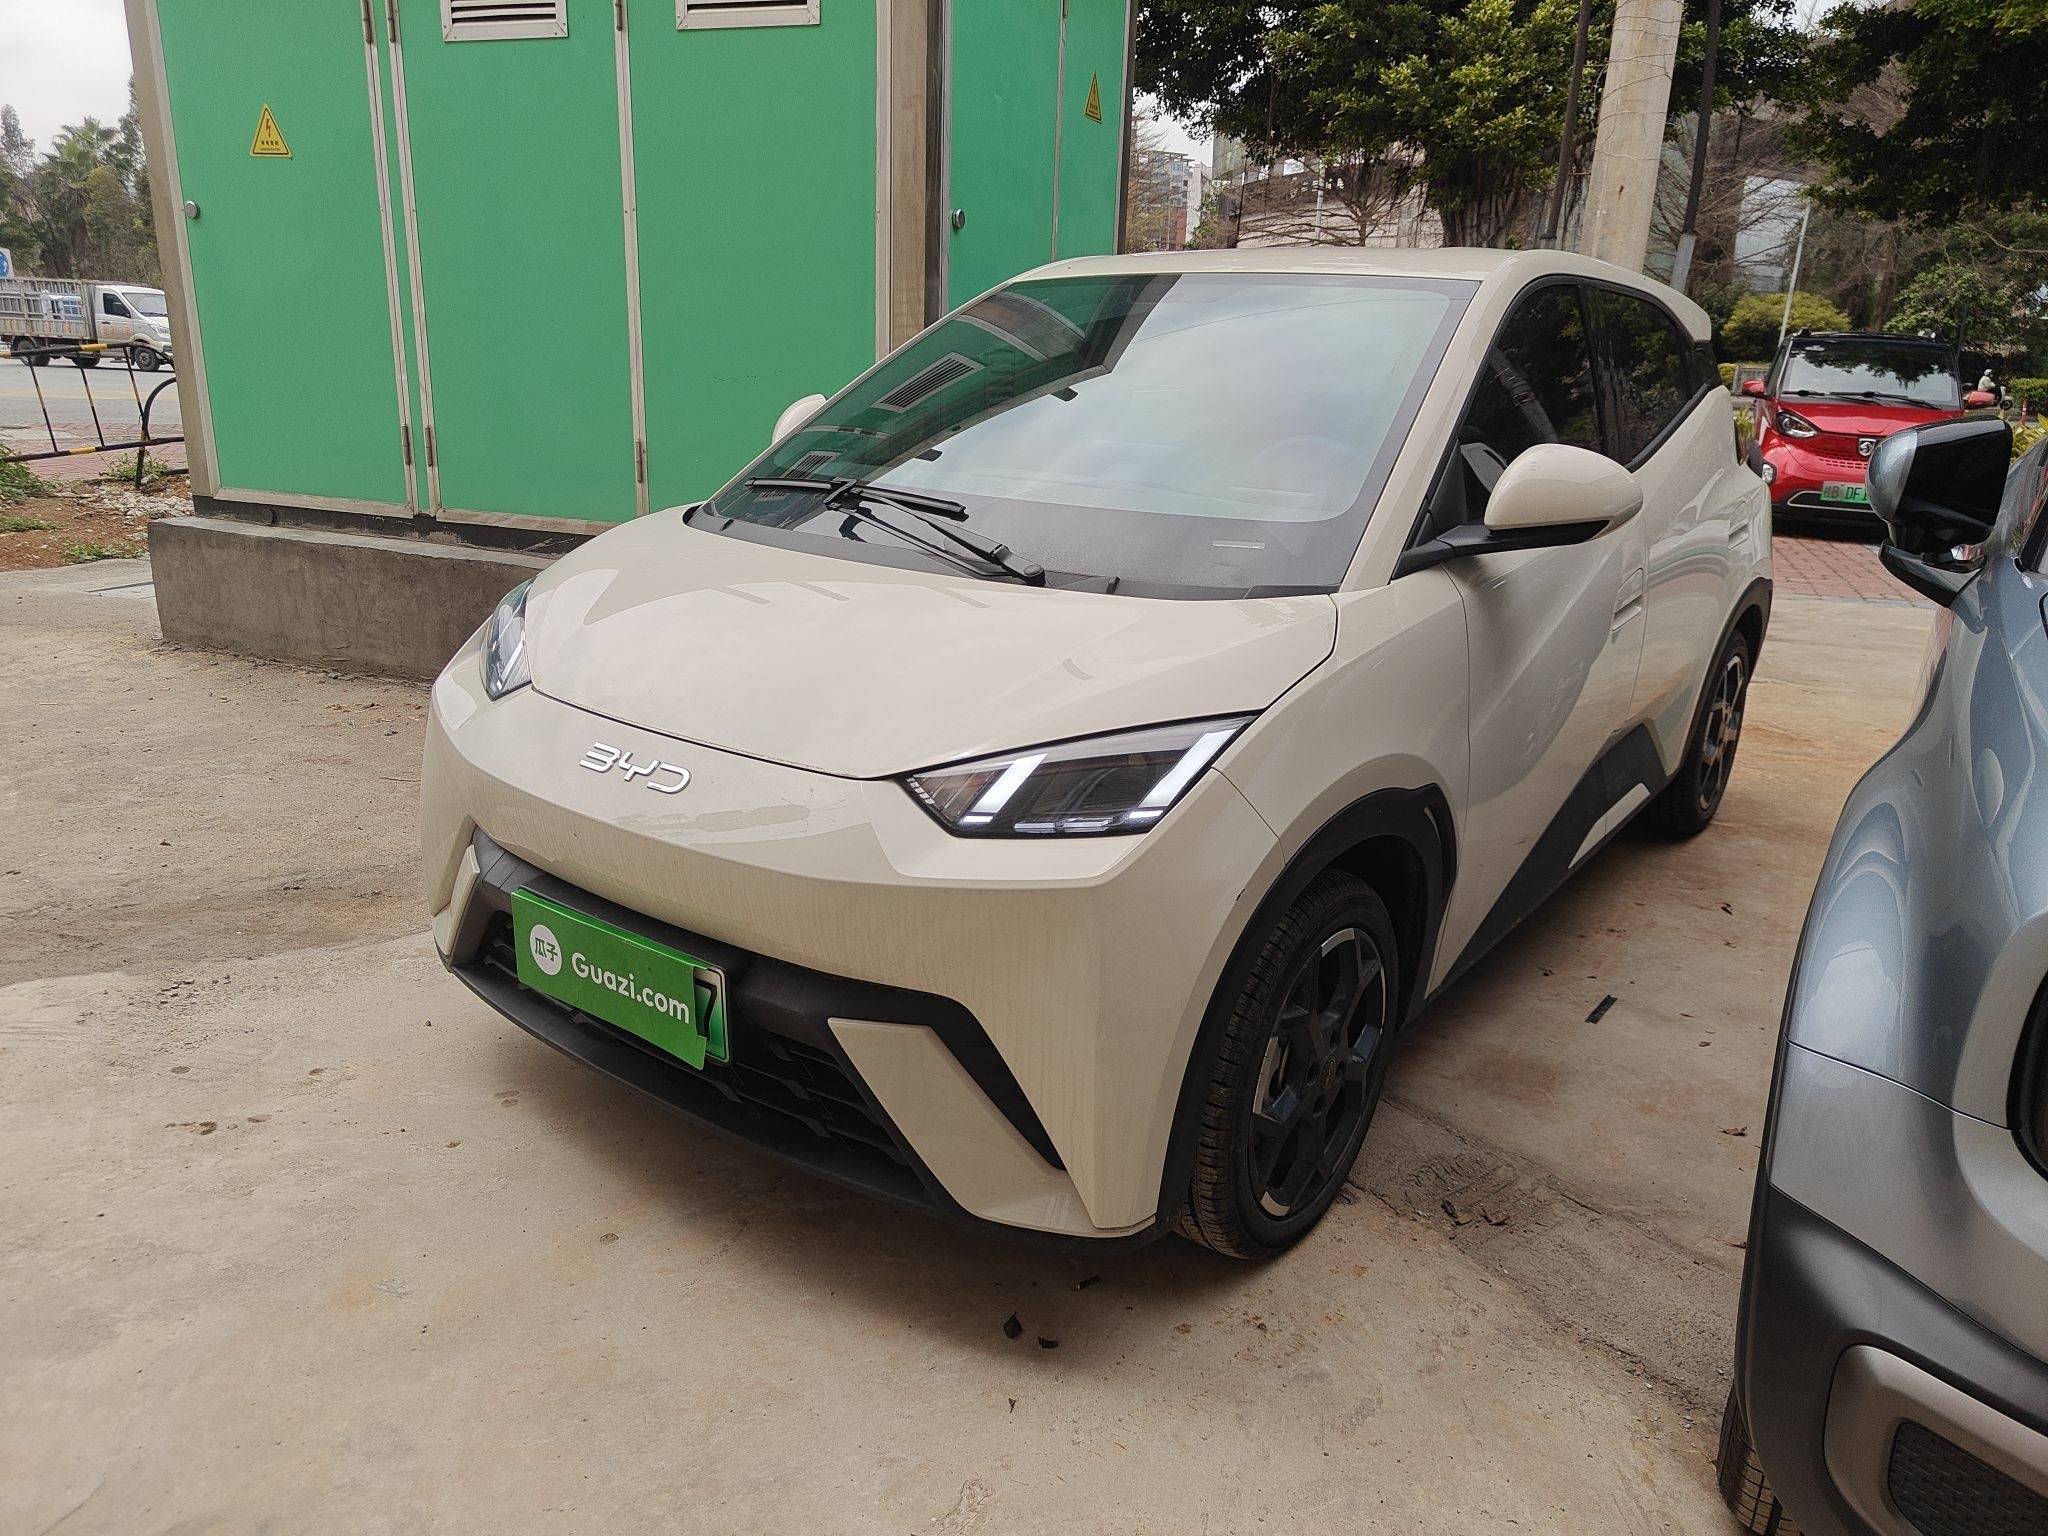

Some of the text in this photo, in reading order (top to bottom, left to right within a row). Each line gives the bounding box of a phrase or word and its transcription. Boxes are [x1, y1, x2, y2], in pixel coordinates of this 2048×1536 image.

[579, 742, 693, 794] BYD
[535, 937, 690, 1024] 瓜子 Guazi.com
